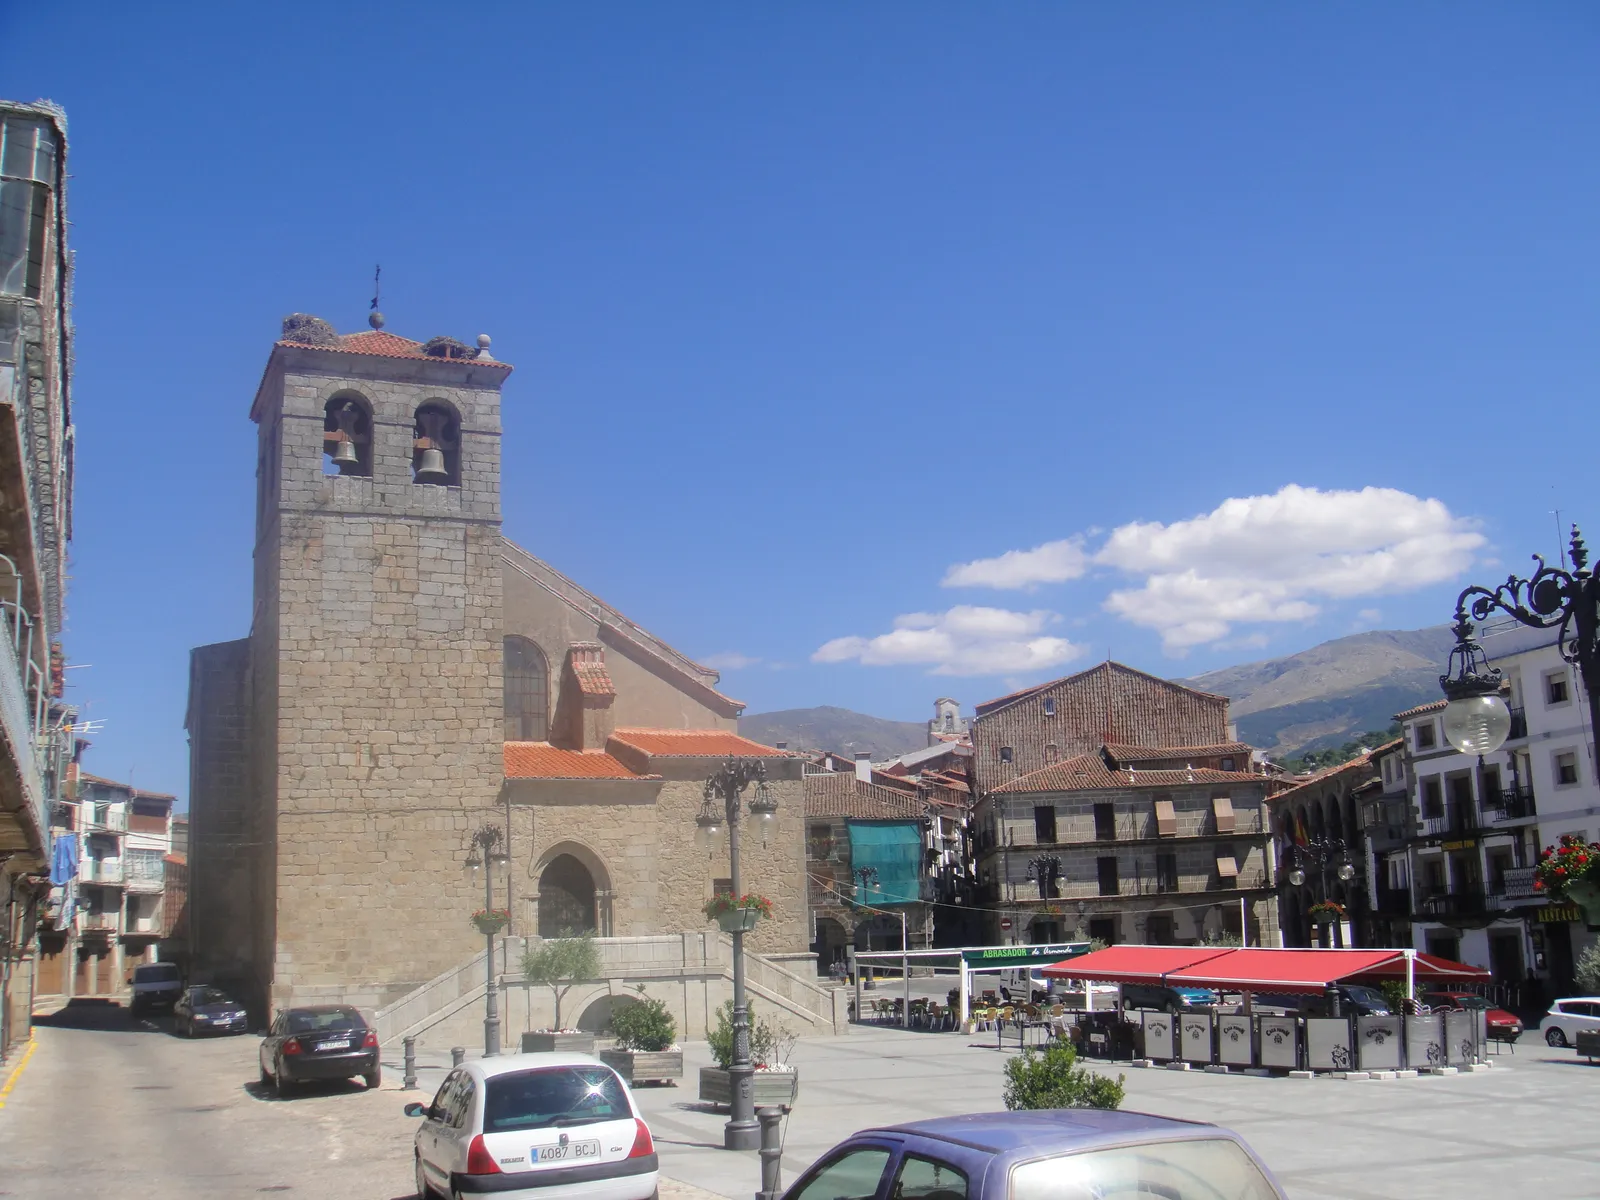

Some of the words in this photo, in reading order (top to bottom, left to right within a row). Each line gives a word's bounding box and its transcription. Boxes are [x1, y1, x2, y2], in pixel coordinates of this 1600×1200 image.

[982, 948, 1027, 958] ABRASADOR
[1031, 948, 1040, 956] de
[1043, 946, 1073, 955] Armando
[541, 1146, 569, 1160] 4087
[575, 1143, 597, 1156] BCJ
